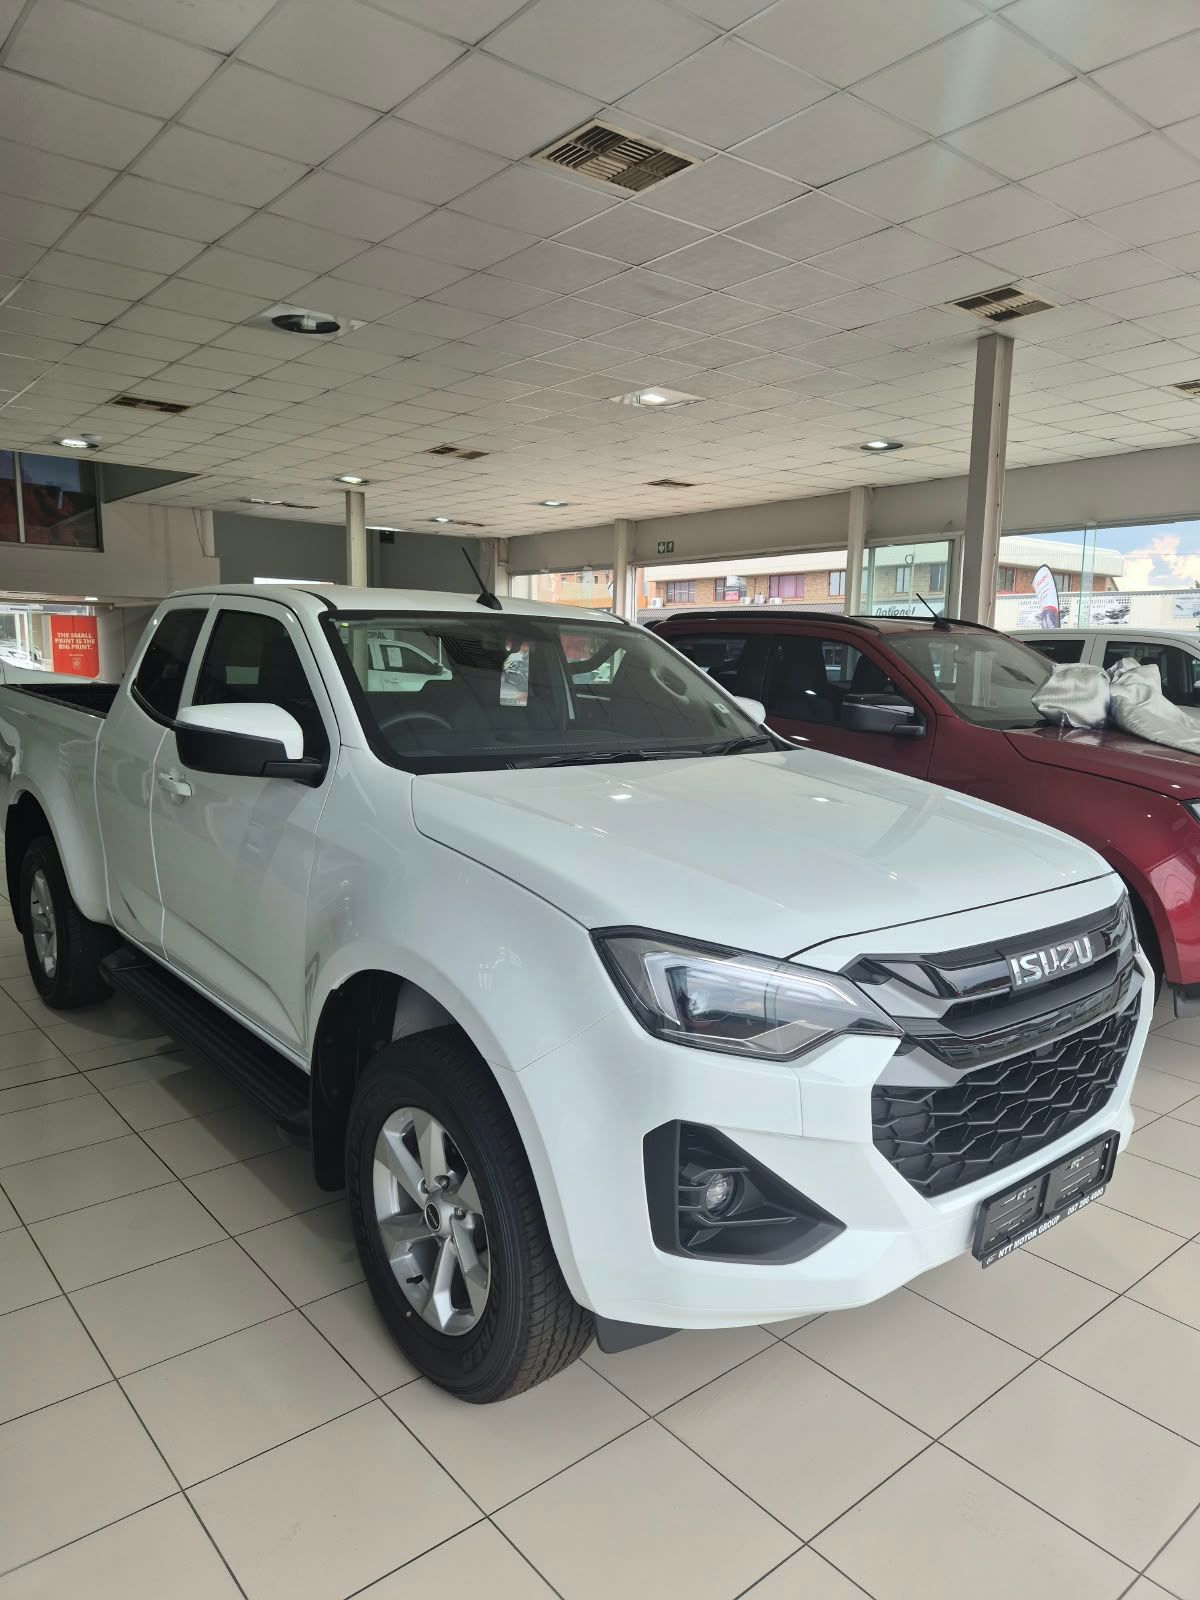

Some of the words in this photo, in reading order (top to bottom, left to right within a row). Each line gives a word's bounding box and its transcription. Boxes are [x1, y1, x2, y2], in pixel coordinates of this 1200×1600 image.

[1010, 936, 1092, 986] ISUZU
[998, 1243, 1014, 1258] NTT
[1014, 1228, 1037, 1249] MOTOR
[1038, 1215, 1061, 1234] GROUP
